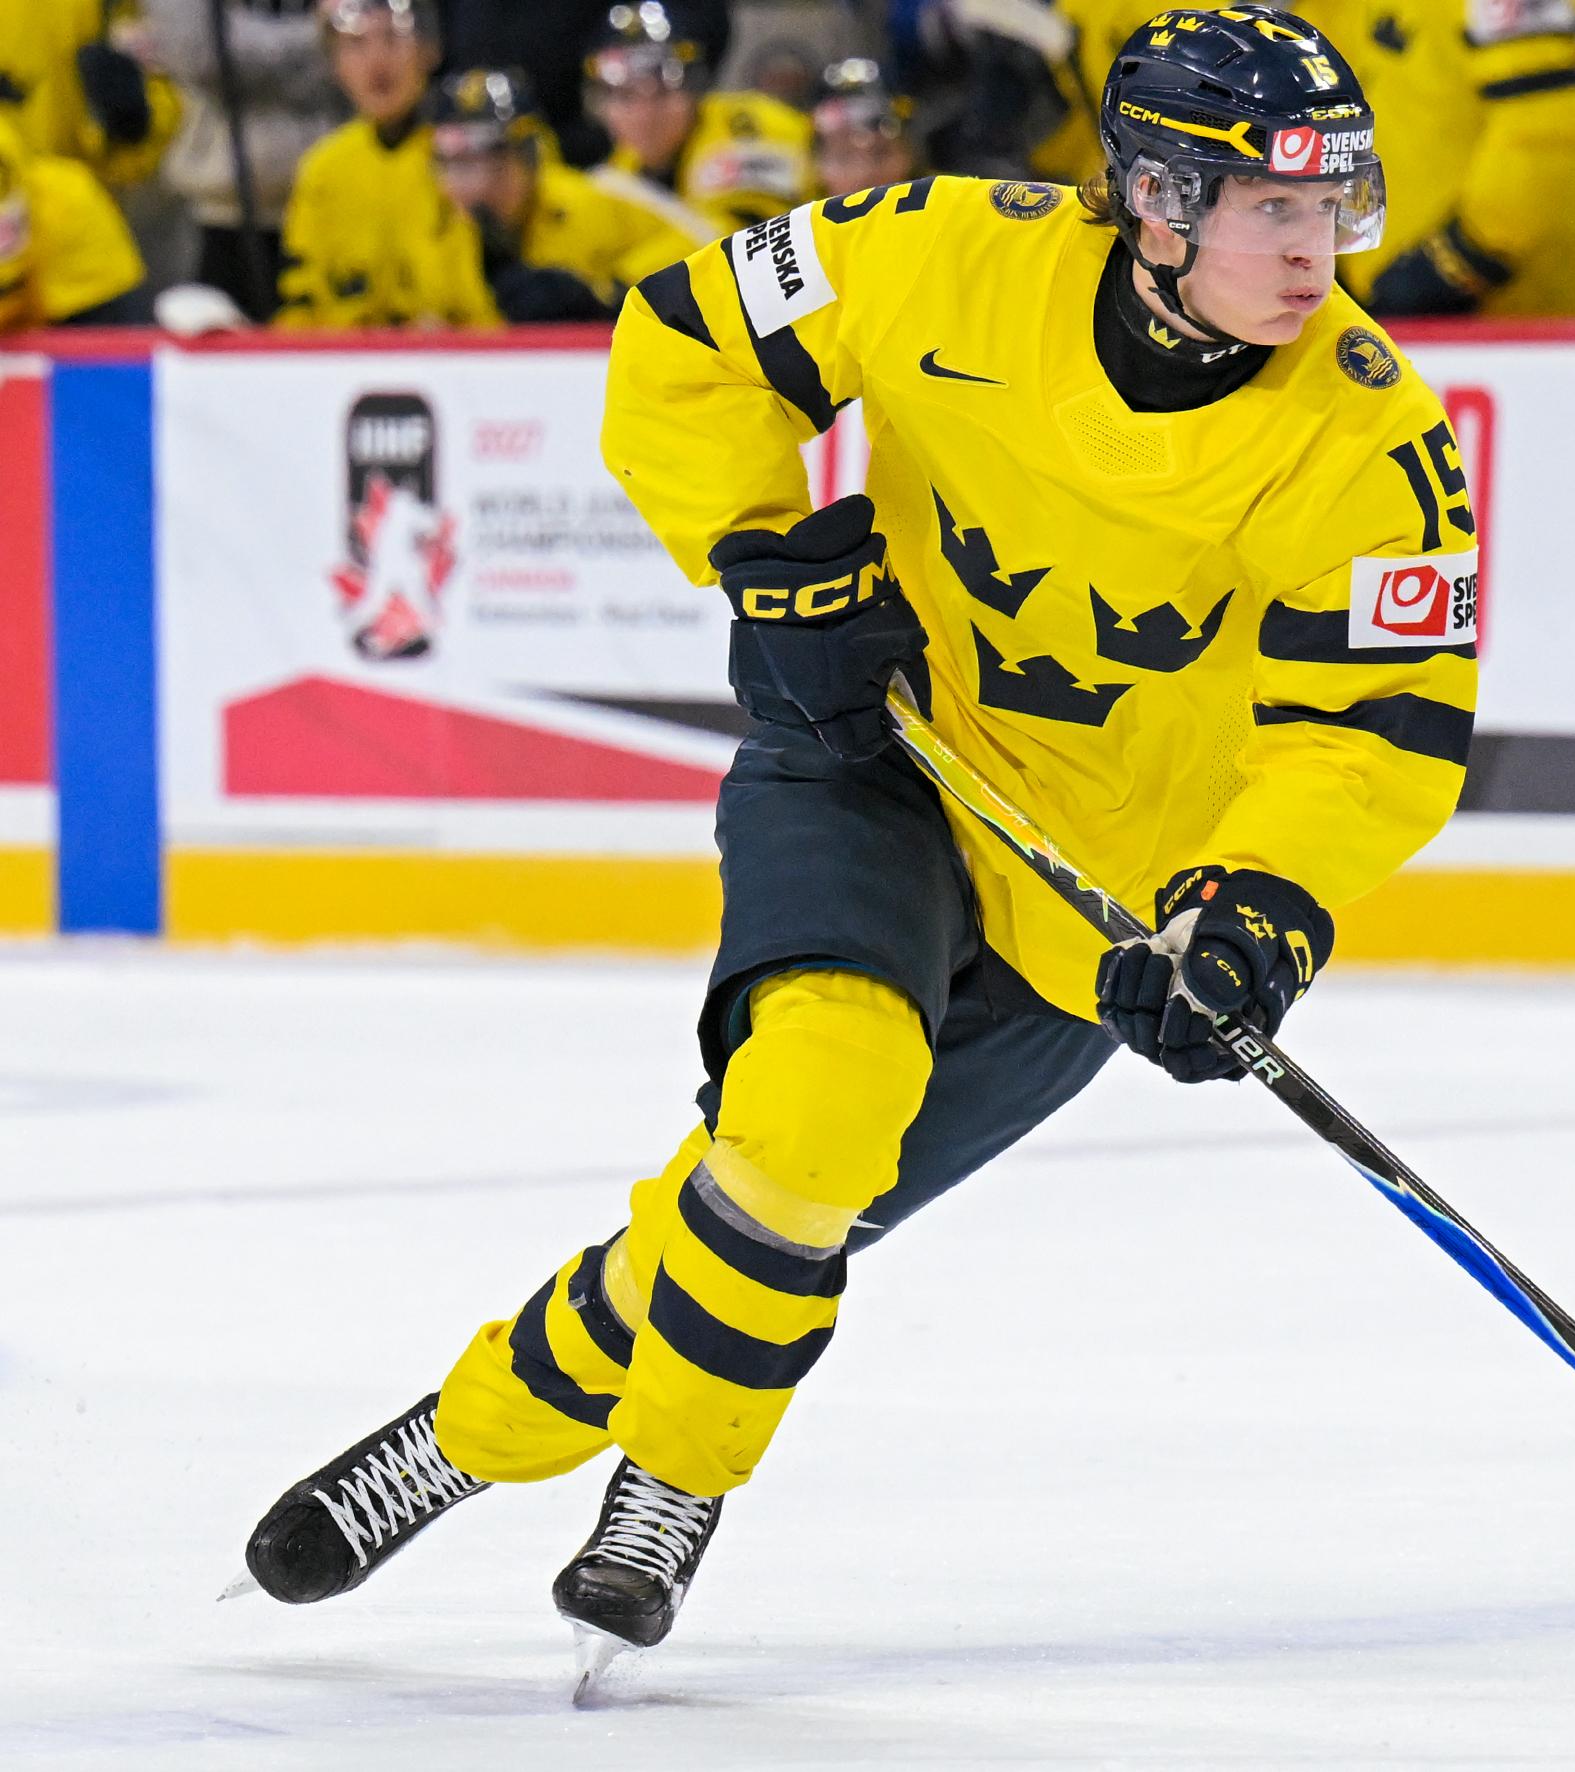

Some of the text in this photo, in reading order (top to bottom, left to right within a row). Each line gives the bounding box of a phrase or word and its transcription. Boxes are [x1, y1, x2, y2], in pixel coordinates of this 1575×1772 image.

[1301, 55, 1339, 91] 15
[1119, 102, 1161, 124] CCM
[1320, 153, 1354, 174] SPEL
[1168, 222, 1190, 231] CCM
[1386, 420, 1475, 552] 15
[742, 548, 895, 619] CCM
[1164, 868, 1203, 914] CCM
